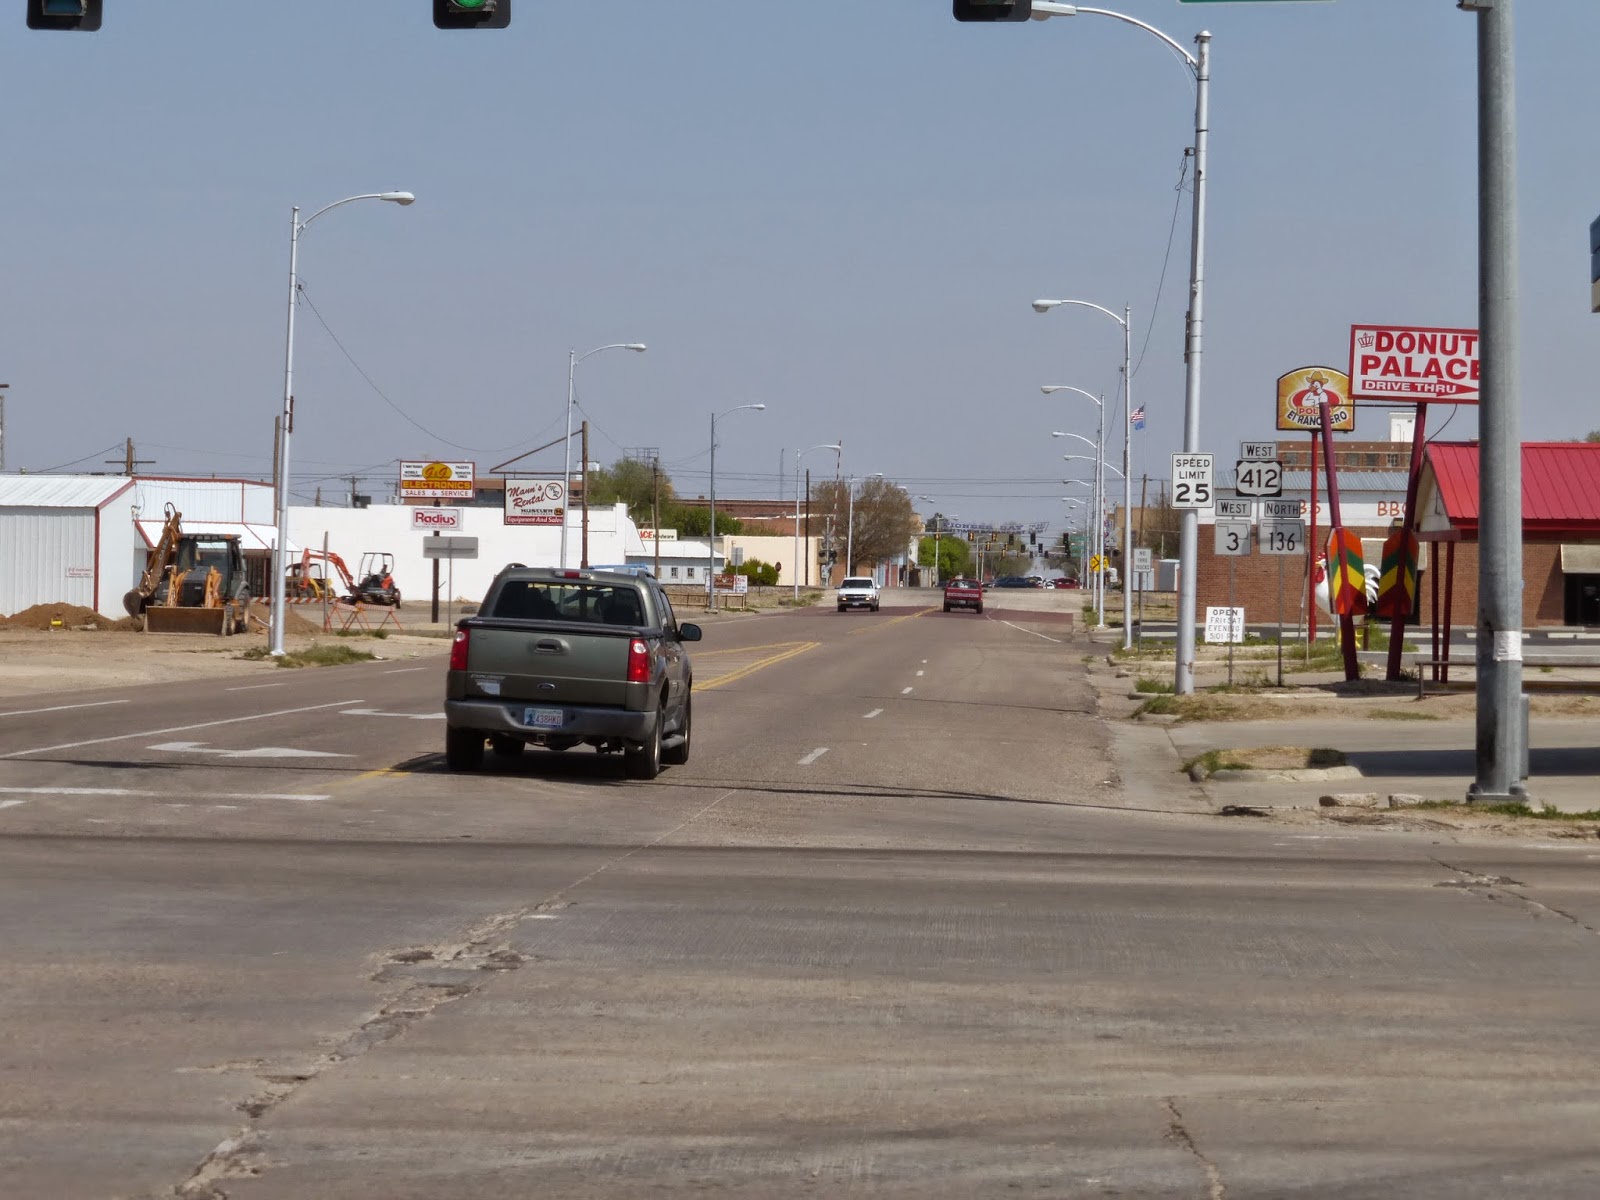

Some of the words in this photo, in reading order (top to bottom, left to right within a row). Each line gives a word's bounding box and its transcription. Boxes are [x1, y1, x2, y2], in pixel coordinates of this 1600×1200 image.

[1375, 331, 1478, 356] DONUT
[1365, 380, 1411, 391] DRIVE
[1415, 383, 1457, 393] THRU
[1246, 444, 1273, 457] WEST
[1175, 458, 1210, 468] SPEED
[1179, 471, 1206, 480] LIMIT
[1240, 469, 1278, 488] 412
[403, 480, 471, 489] ELECTRONICS
[507, 483, 543, 497] Mann's
[1175, 483, 1210, 503] 25
[512, 491, 545, 510] Rental
[1220, 502, 1247, 514] WEST
[1266, 503, 1299, 515] NORTH
[415, 511, 456, 526] Radius
[1226, 532, 1239, 551] 3
[1269, 532, 1295, 551] 136
